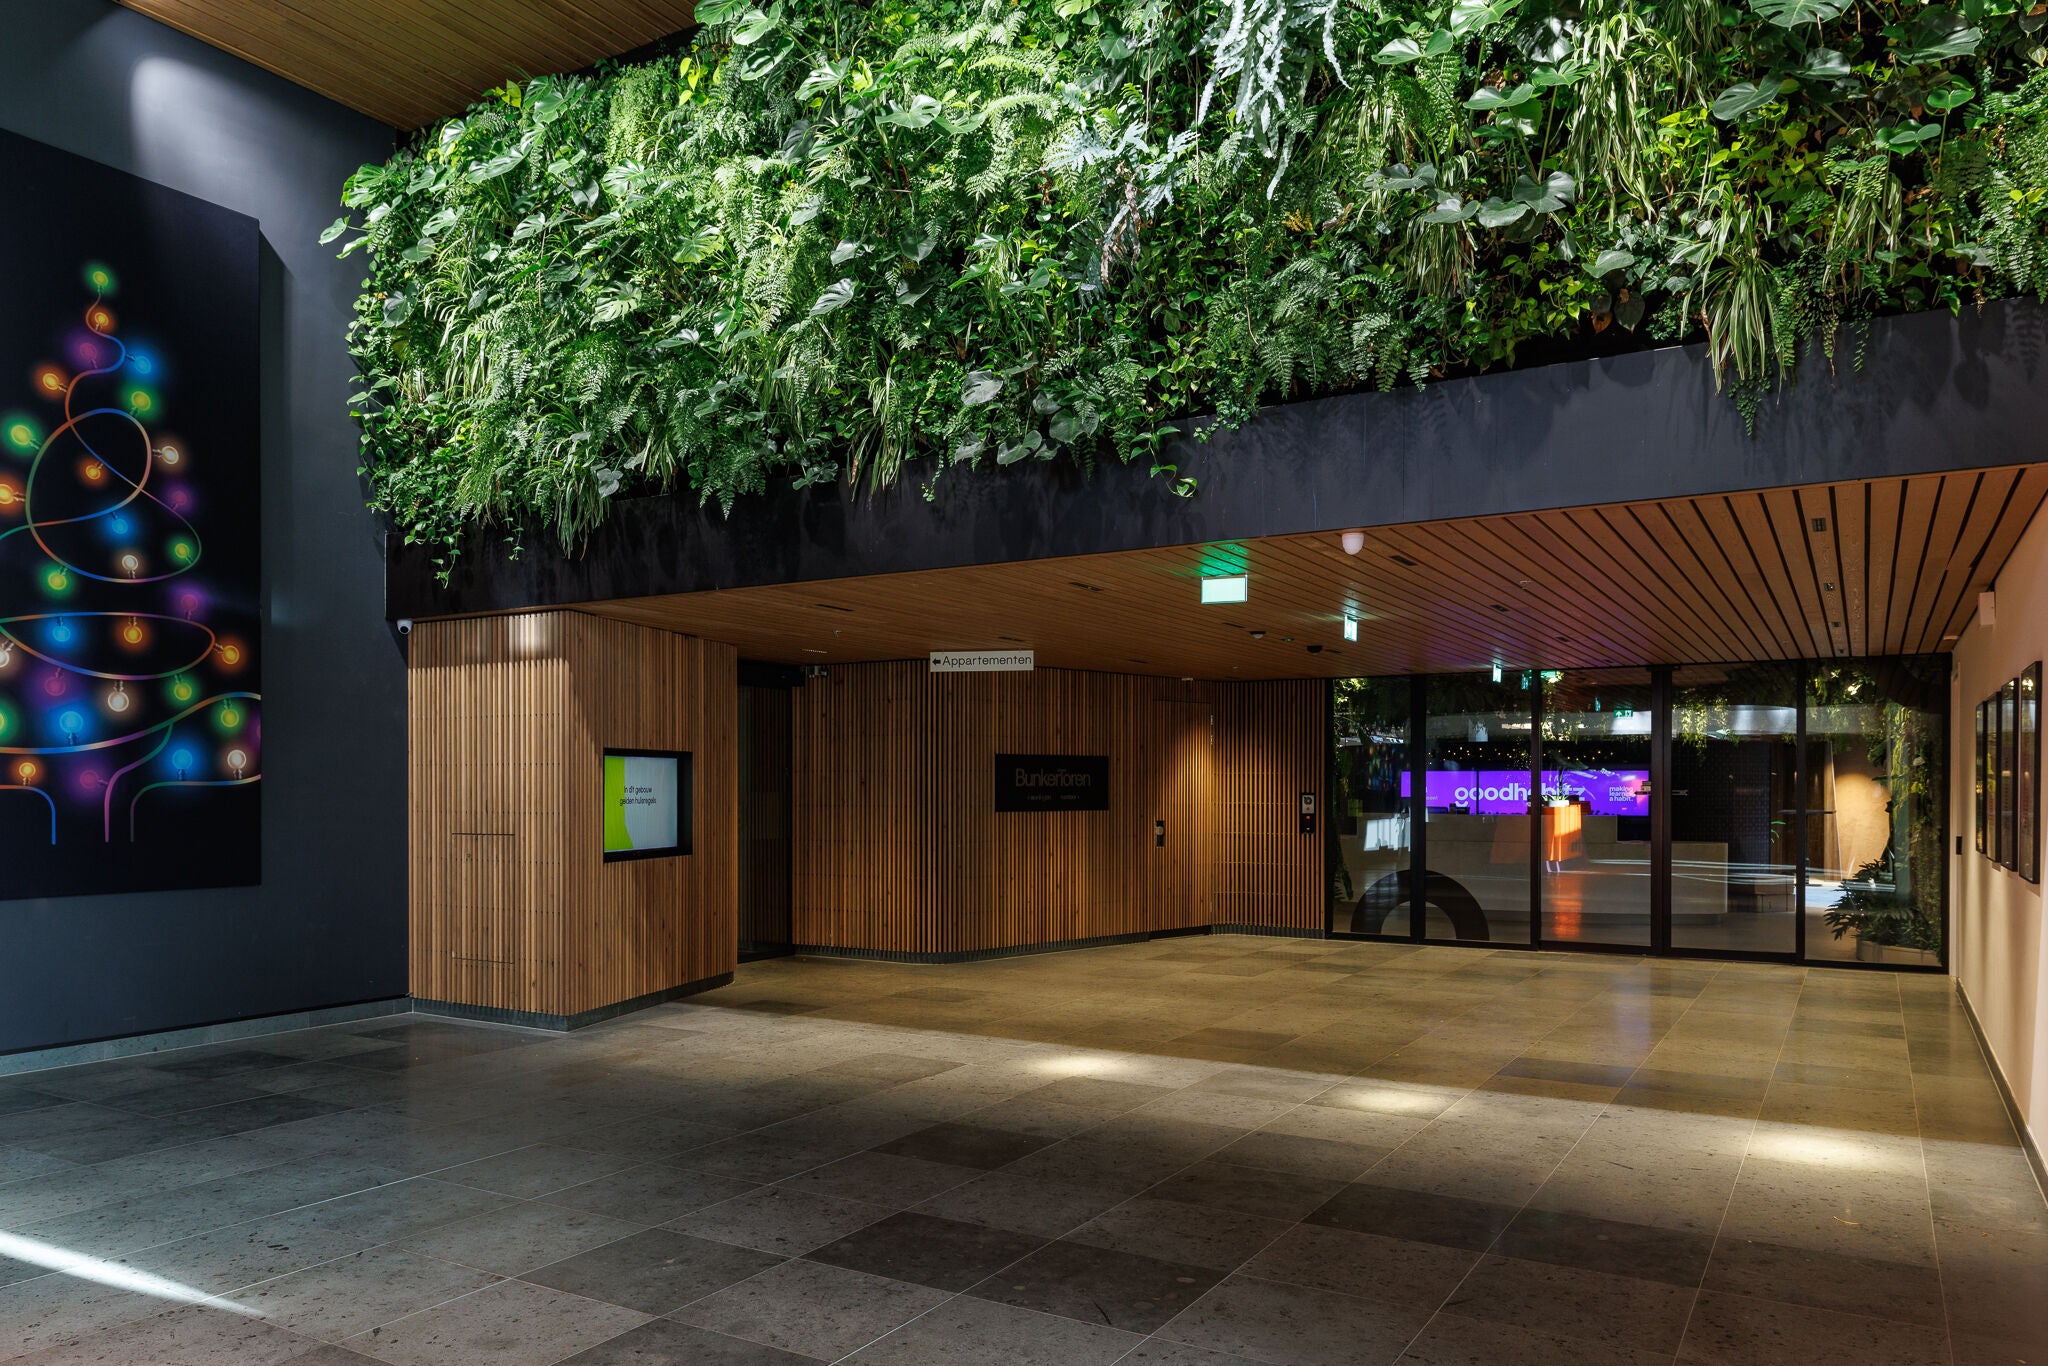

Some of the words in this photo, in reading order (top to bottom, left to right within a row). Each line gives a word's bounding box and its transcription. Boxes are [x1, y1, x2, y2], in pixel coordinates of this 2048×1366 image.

[942, 655, 1032, 668] Appartementen
[1015, 767, 1091, 787] BunkerToren
[635, 786, 653, 796] gebouw
[1454, 782, 1586, 808] goodhbitz
